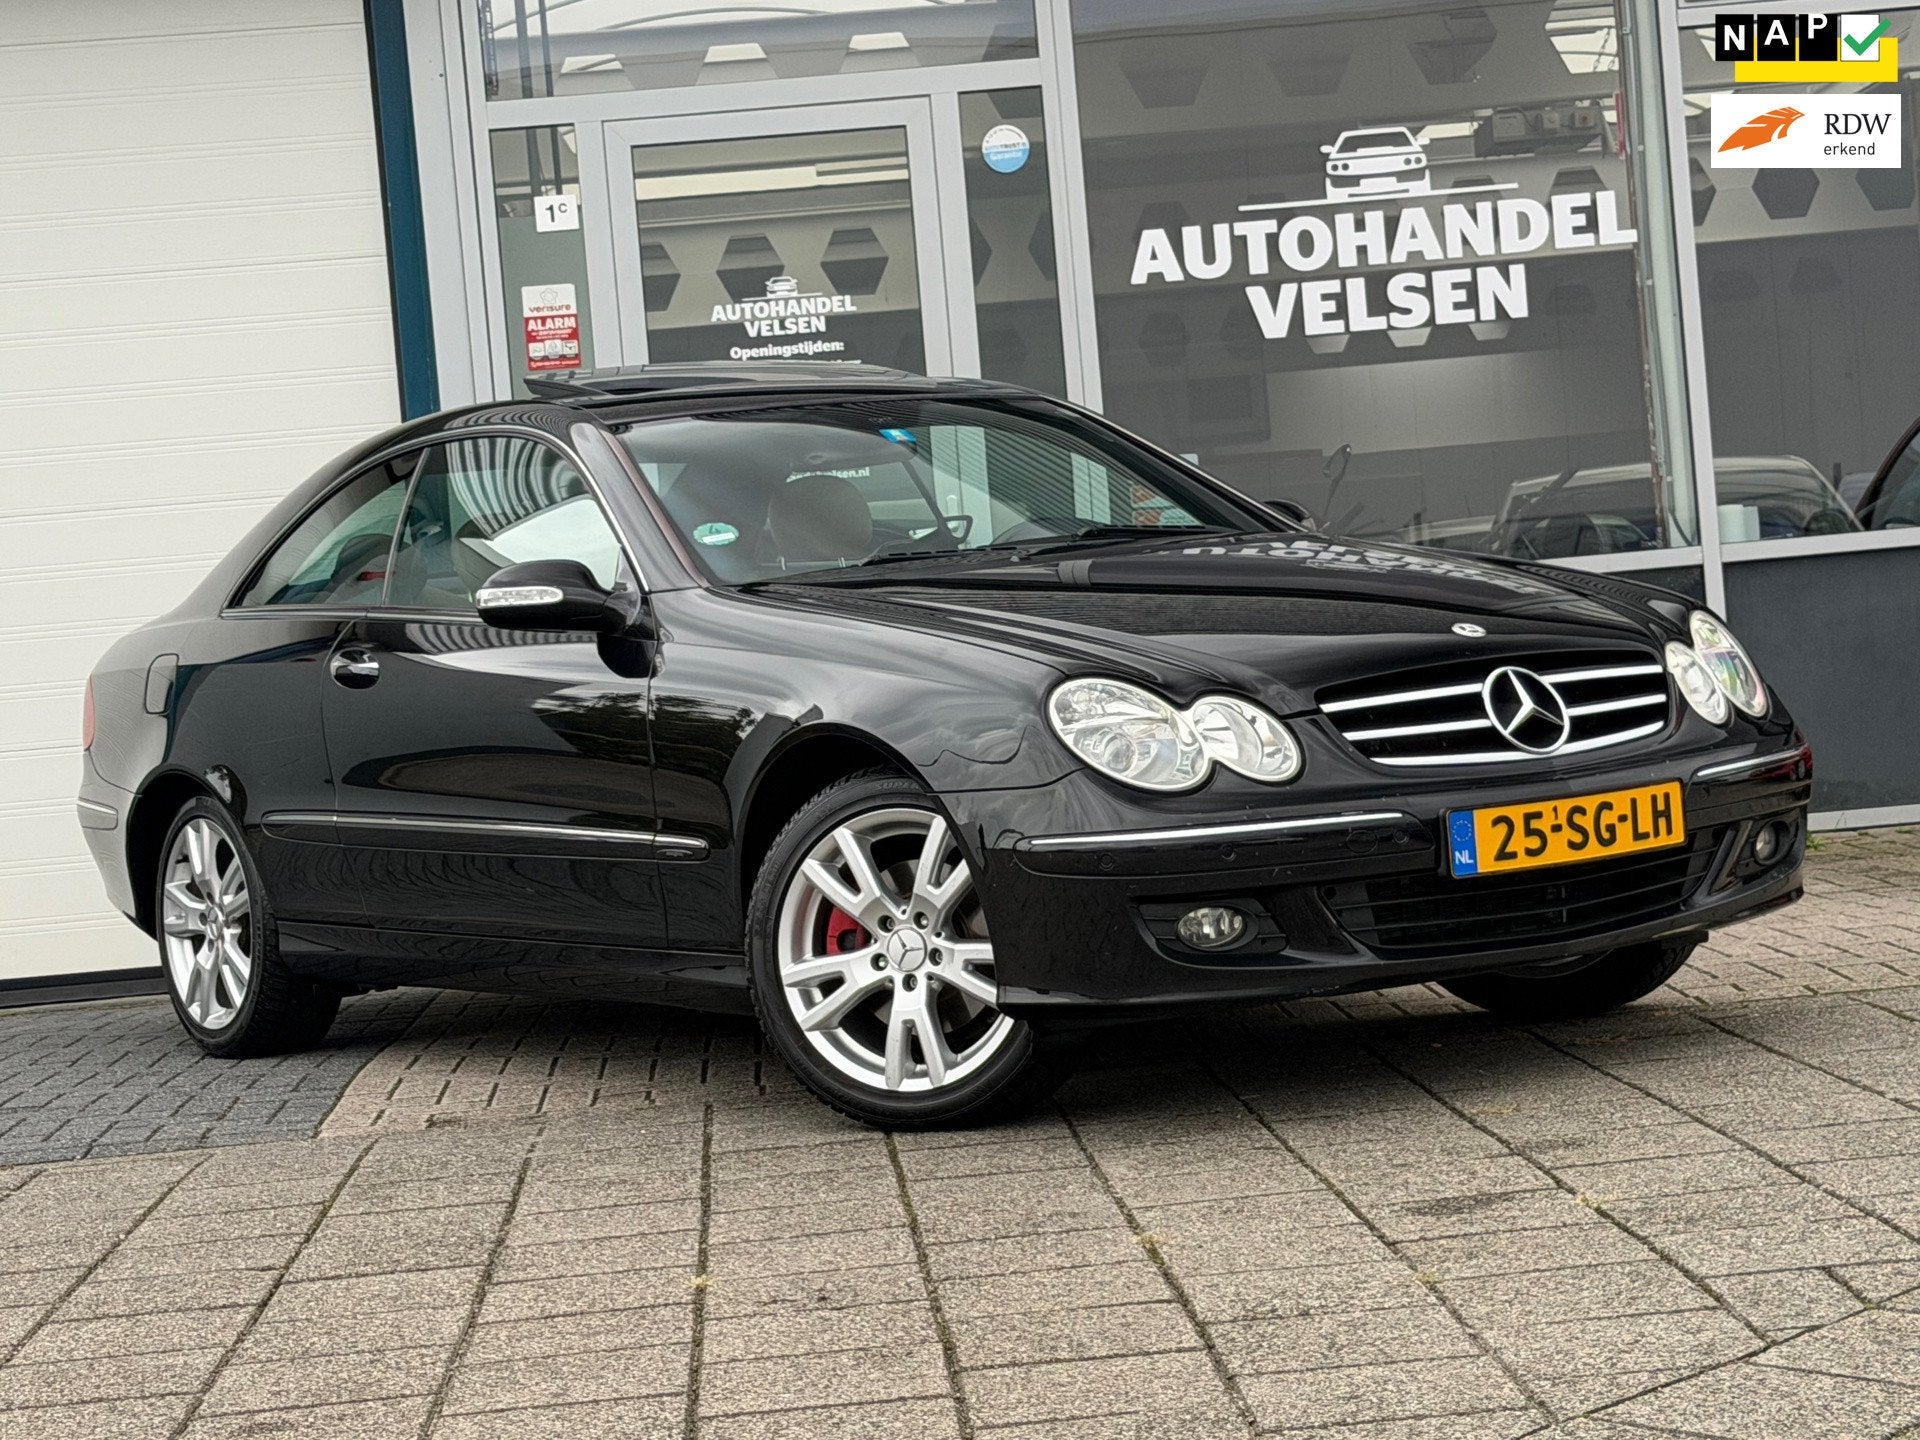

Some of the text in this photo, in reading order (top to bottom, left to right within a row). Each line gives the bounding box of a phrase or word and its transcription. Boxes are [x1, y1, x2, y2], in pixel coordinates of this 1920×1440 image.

[1130, 190, 1639, 285] AUTOHANDEL
[528, 303, 572, 313] verisure
[711, 295, 858, 323] AUTOHANDEL
[1245, 263, 1530, 340] VELSEN
[527, 316, 577, 332] ALARM
[743, 315, 827, 338] VELSEN
[730, 340, 845, 361] Openingstijden:
[1490, 791, 1674, 862] 25-SG-LH
[1455, 849, 1474, 865] NL
